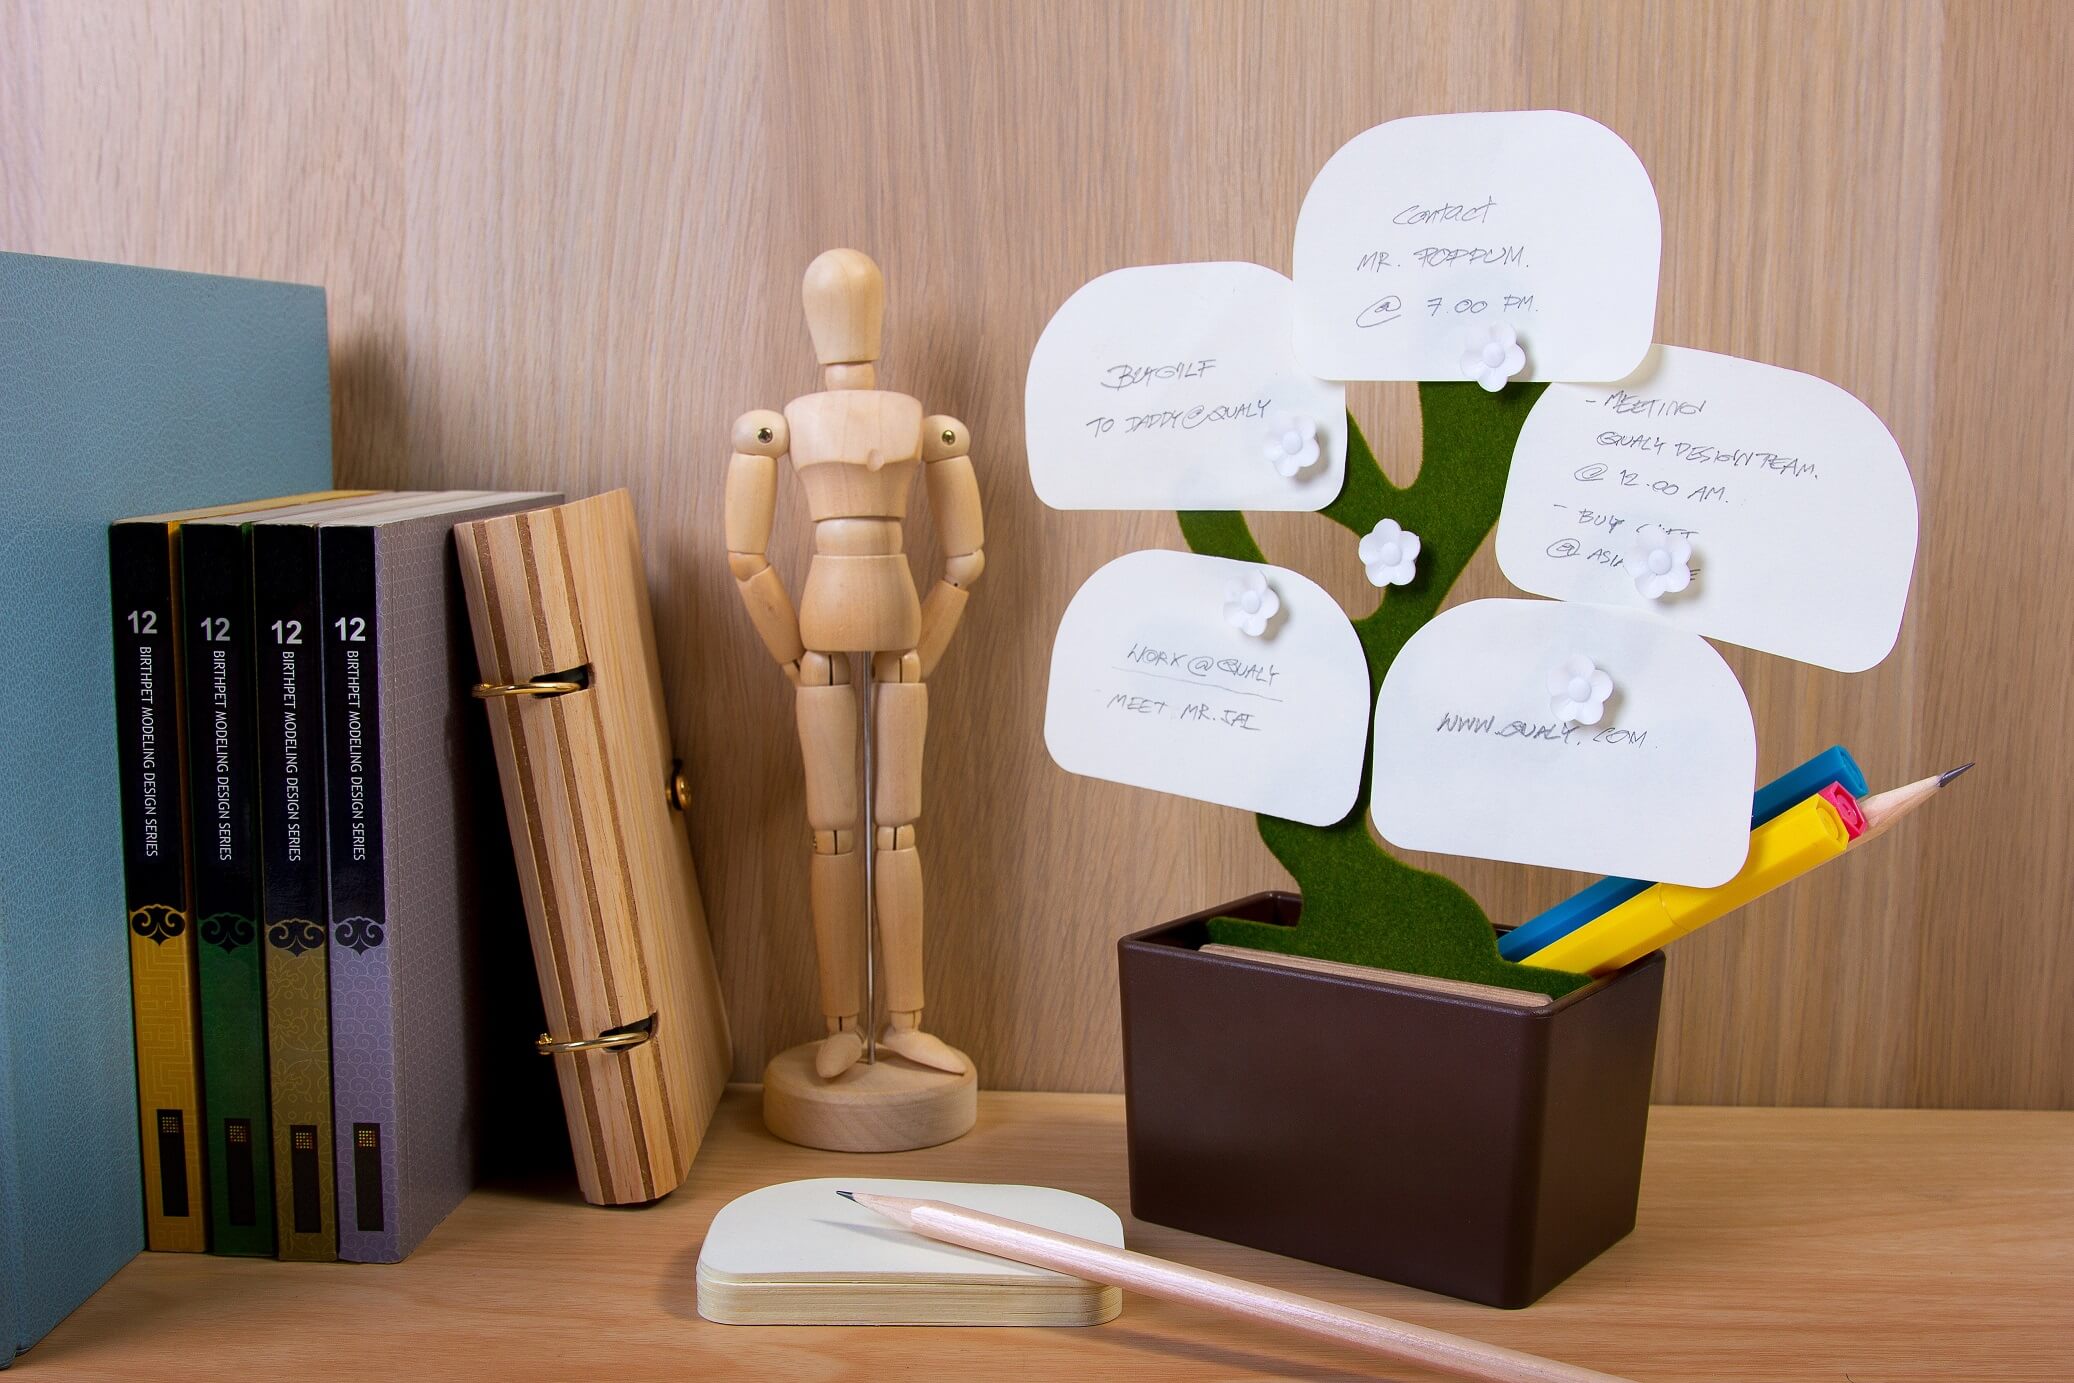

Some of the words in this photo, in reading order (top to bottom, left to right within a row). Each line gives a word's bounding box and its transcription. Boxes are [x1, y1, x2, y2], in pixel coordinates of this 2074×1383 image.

[1393, 195, 1497, 225] Contact
[1357, 251, 1401, 273] MR.
[1356, 295, 1402, 328] @
[1086, 417, 1115, 438] TO
[1578, 508, 1625, 534] BUY
[127, 610, 158, 634] 12
[200, 617, 231, 642] 12
[271, 620, 303, 645] 12
[334, 617, 366, 641] 12
[139, 646, 153, 704] BIRTHPET
[213, 650, 227, 708] BIRTHPET
[282, 651, 296, 709] BIRTHPET
[346, 650, 360, 708] BIRTHPET
[1107, 694, 1168, 713] MEET
[141, 706, 155, 769] MODELING
[215, 710, 228, 773] MODELING
[284, 711, 298, 773] MODELING
[348, 710, 361, 773] MODELING
[143, 772, 157, 815] DESIGN
[217, 776, 230, 819] DESIGN
[286, 777, 299, 820] DESIGN
[350, 776, 363, 819] DESIGN
[145, 818, 158, 857] SERIES
[218, 822, 232, 861] SERIES
[288, 823, 301, 862] SERIES
[352, 822, 365, 861] SERIES
